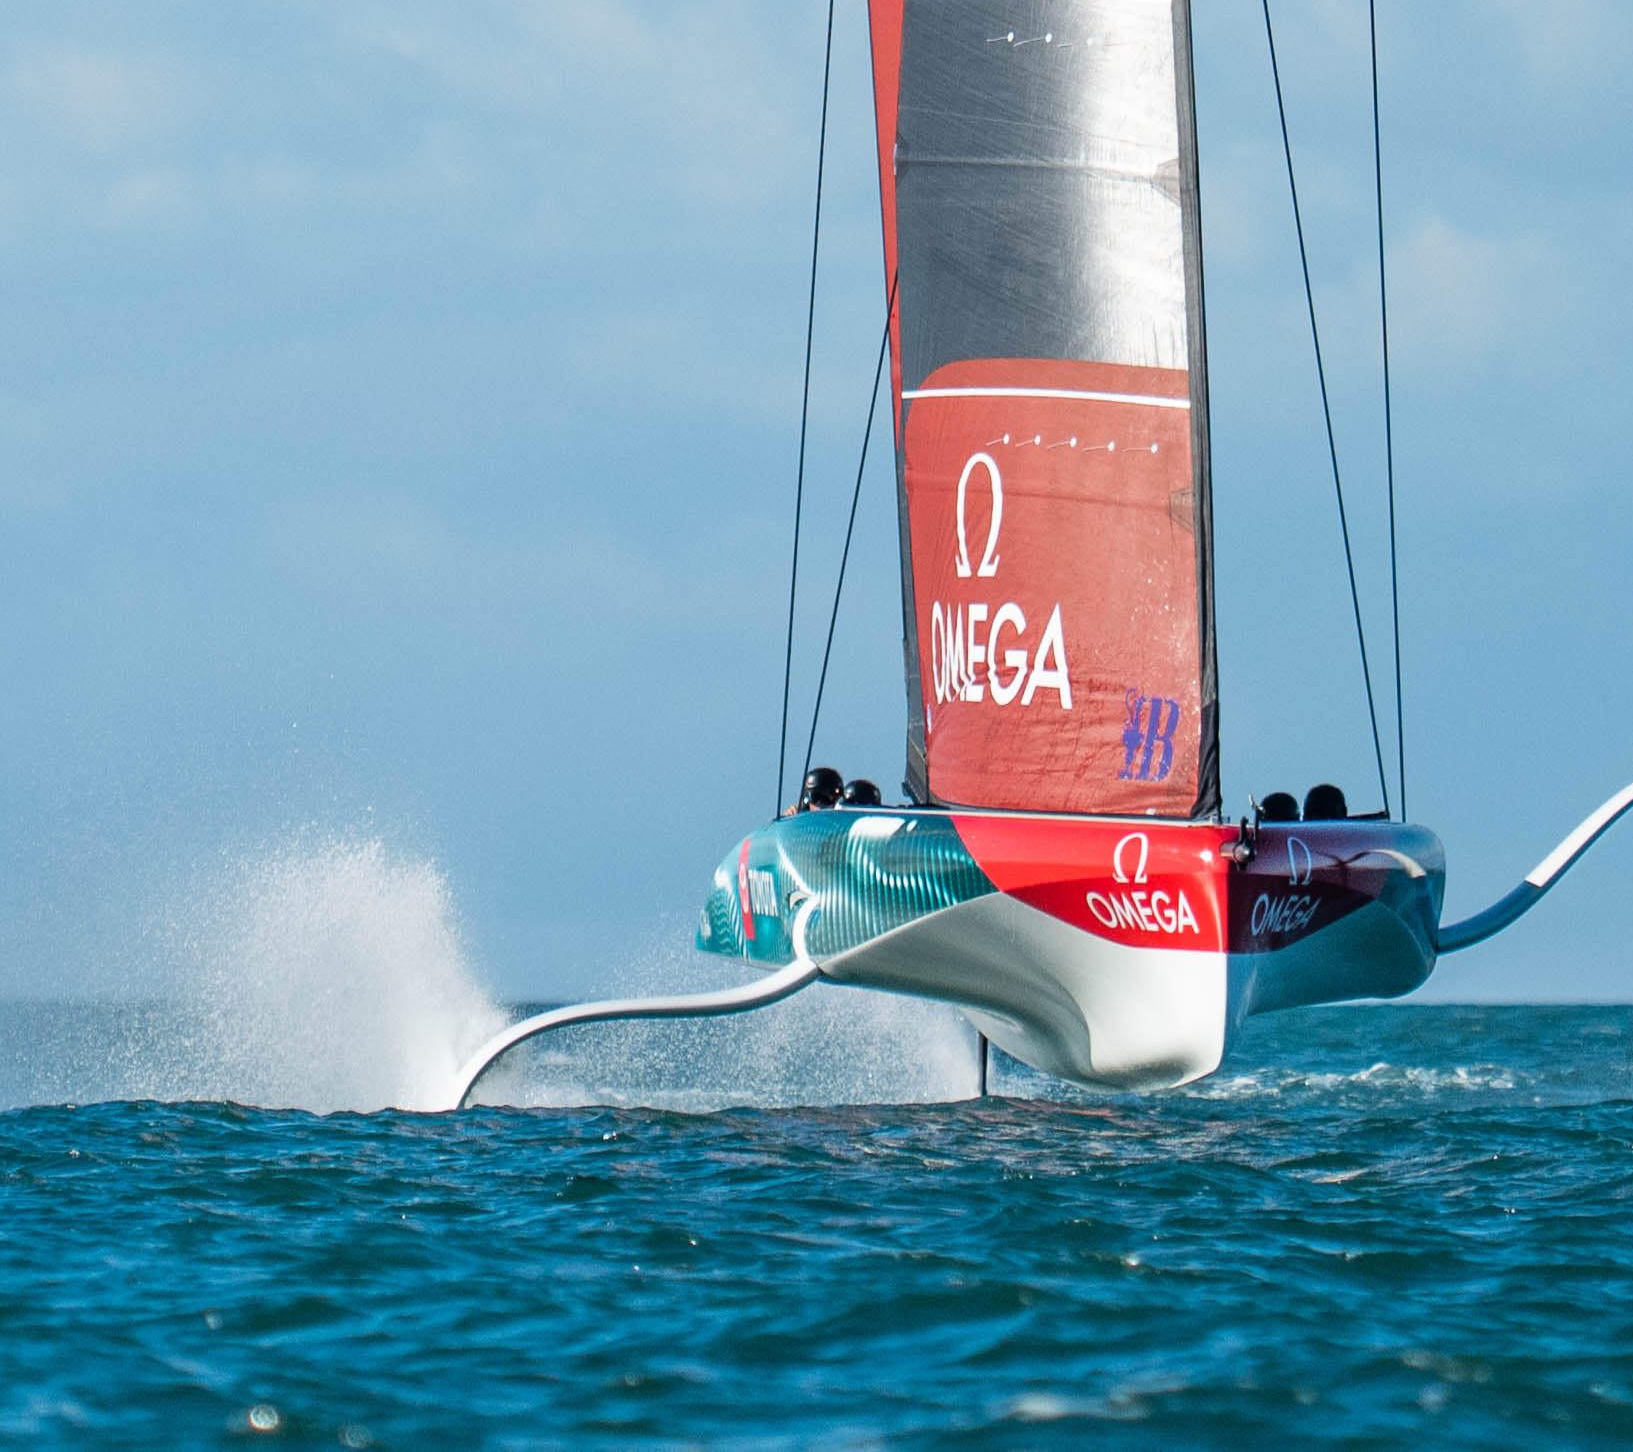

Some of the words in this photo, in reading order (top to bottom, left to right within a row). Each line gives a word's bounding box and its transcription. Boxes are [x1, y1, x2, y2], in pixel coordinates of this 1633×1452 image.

[931, 601, 1073, 710] OMEGA
[1086, 890, 1200, 935] OMEGA
[1251, 893, 1321, 937] OMEGA
